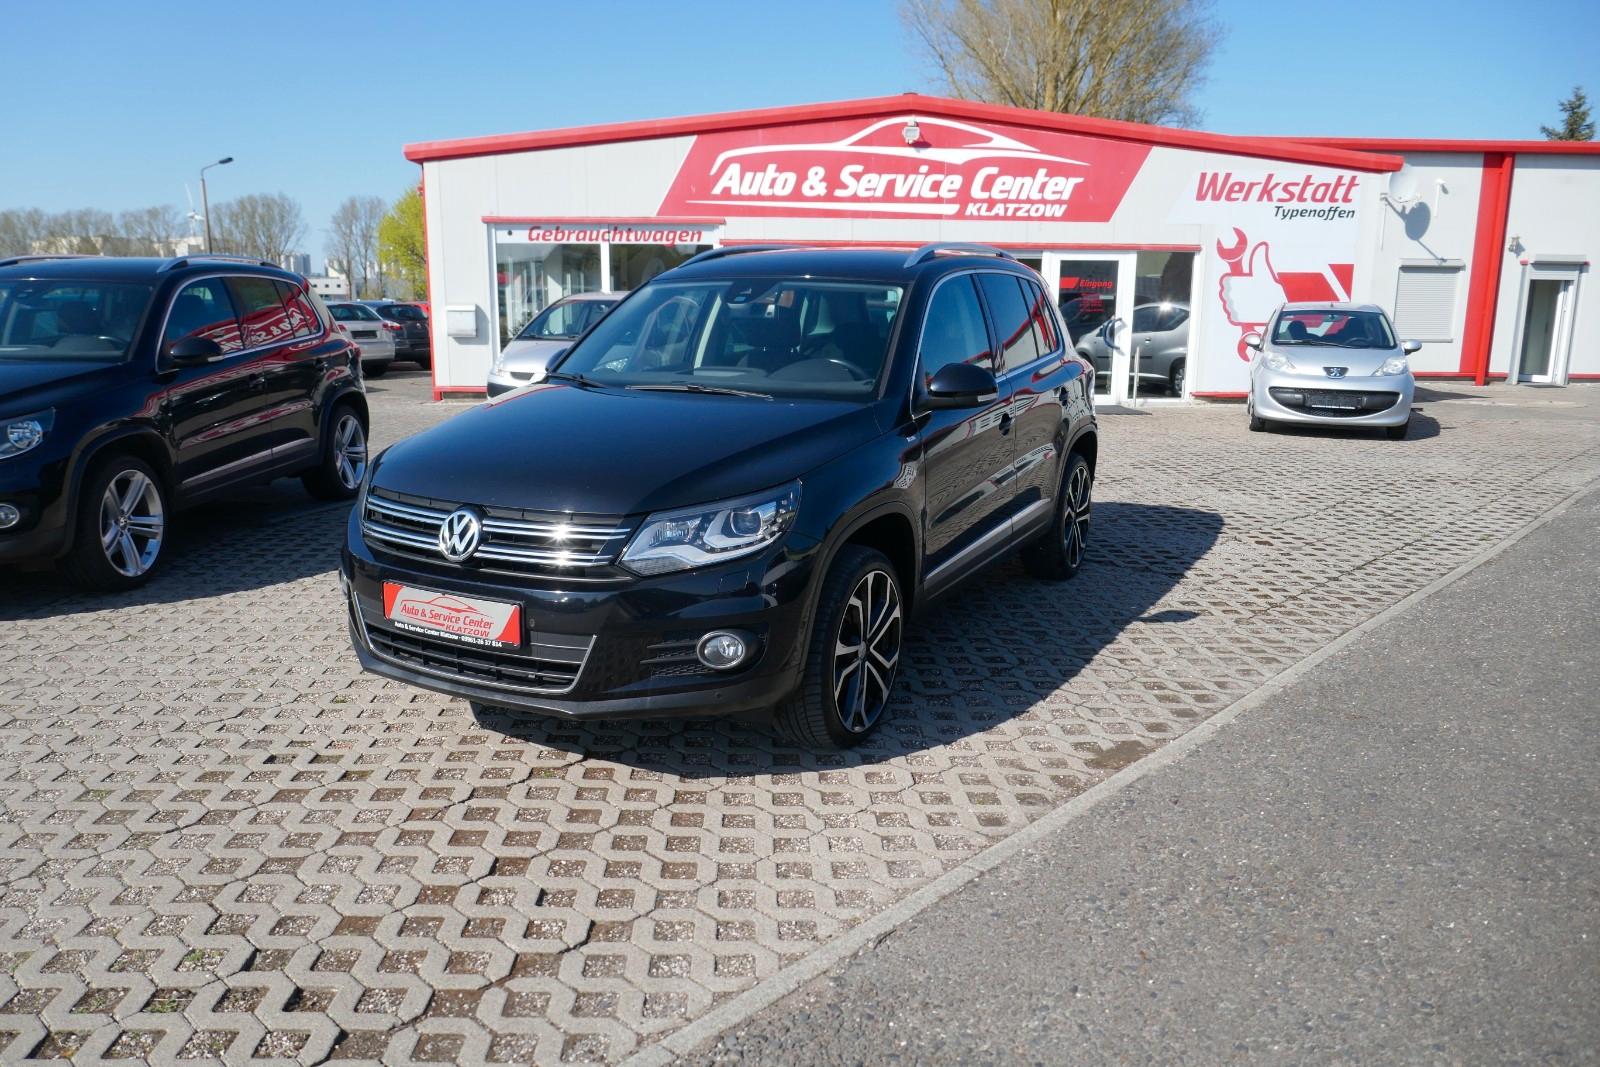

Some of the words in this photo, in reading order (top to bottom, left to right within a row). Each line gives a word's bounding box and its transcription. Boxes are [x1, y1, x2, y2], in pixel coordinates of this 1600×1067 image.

[711, 163, 797, 197] Auto
[801, 166, 828, 197] &
[834, 164, 958, 199] Service
[970, 166, 1084, 201] Center
[1195, 172, 1360, 204] Werkstatt
[965, 202, 1067, 217] KLATZOW
[1274, 205, 1355, 220] Typenoffen
[528, 225, 702, 246] Gebrauchtwagen
[400, 604, 419, 616] Auto
[421, 609, 427, 618] &
[430, 609, 461, 624] Service
[463, 616, 494, 630] Center
[446, 624, 490, 638] KLATZOW
